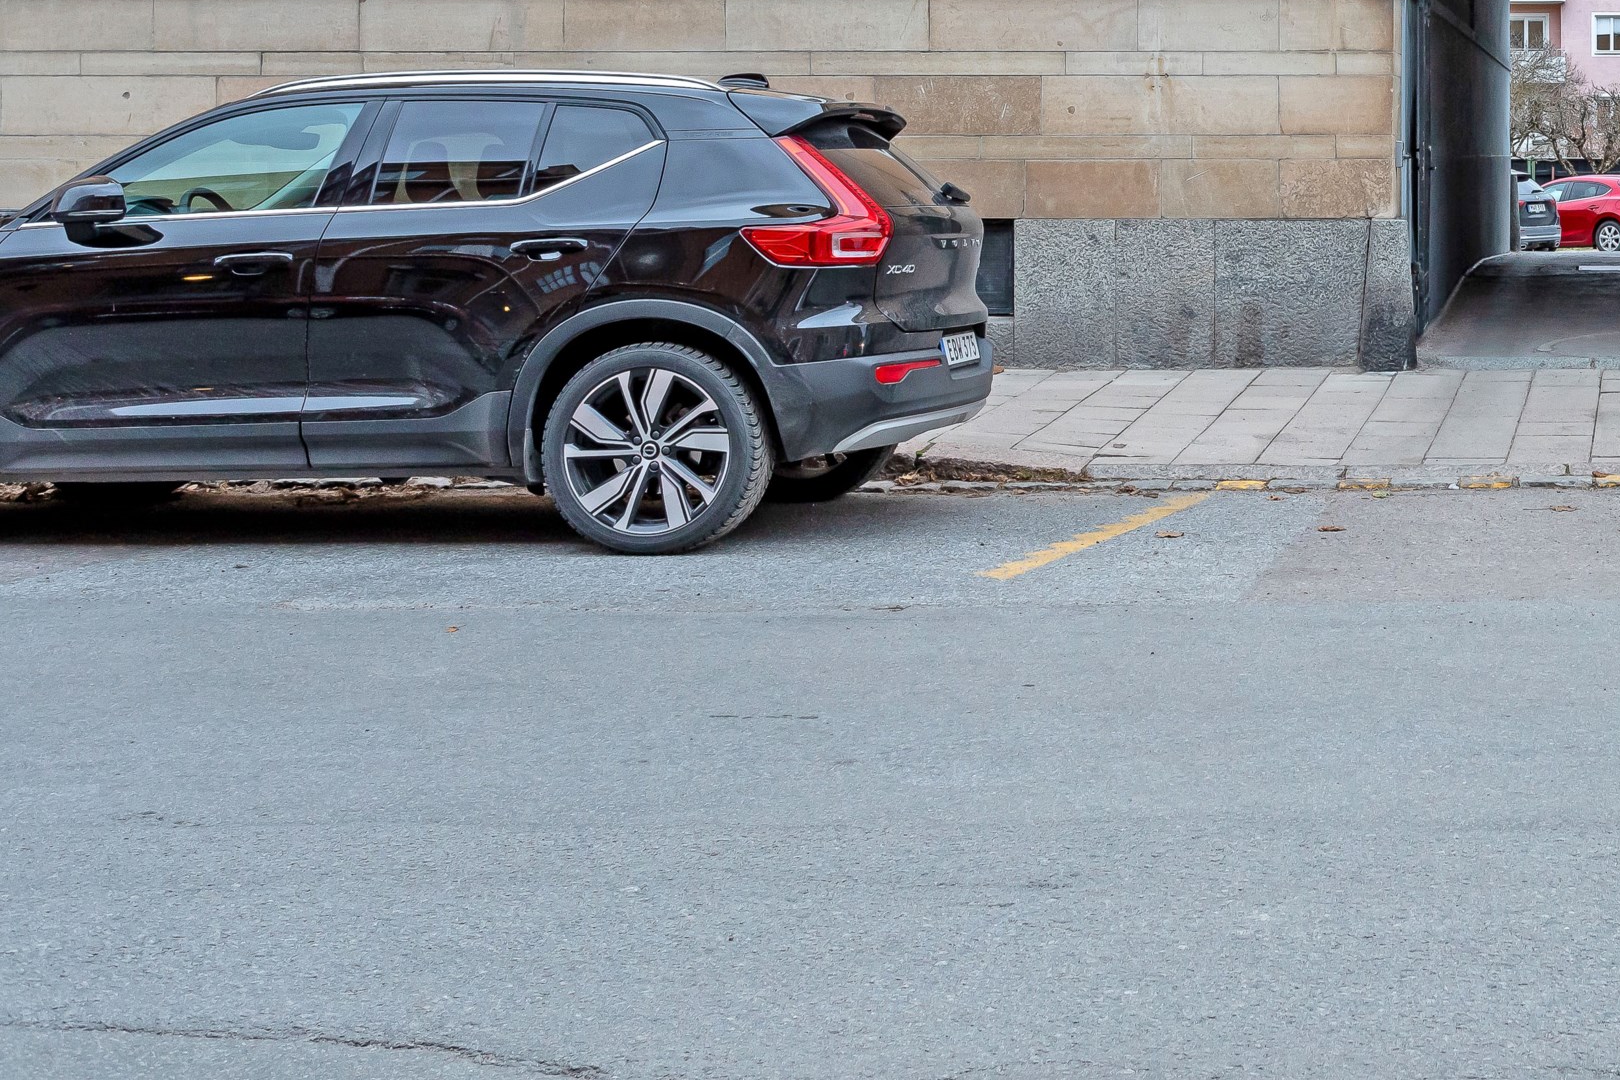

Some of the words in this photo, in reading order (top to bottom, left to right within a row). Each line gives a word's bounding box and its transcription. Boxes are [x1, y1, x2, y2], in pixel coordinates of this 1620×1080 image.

[886, 264, 916, 275] XC40
[946, 336, 963, 361] EBW
[962, 334, 977, 358] 375
